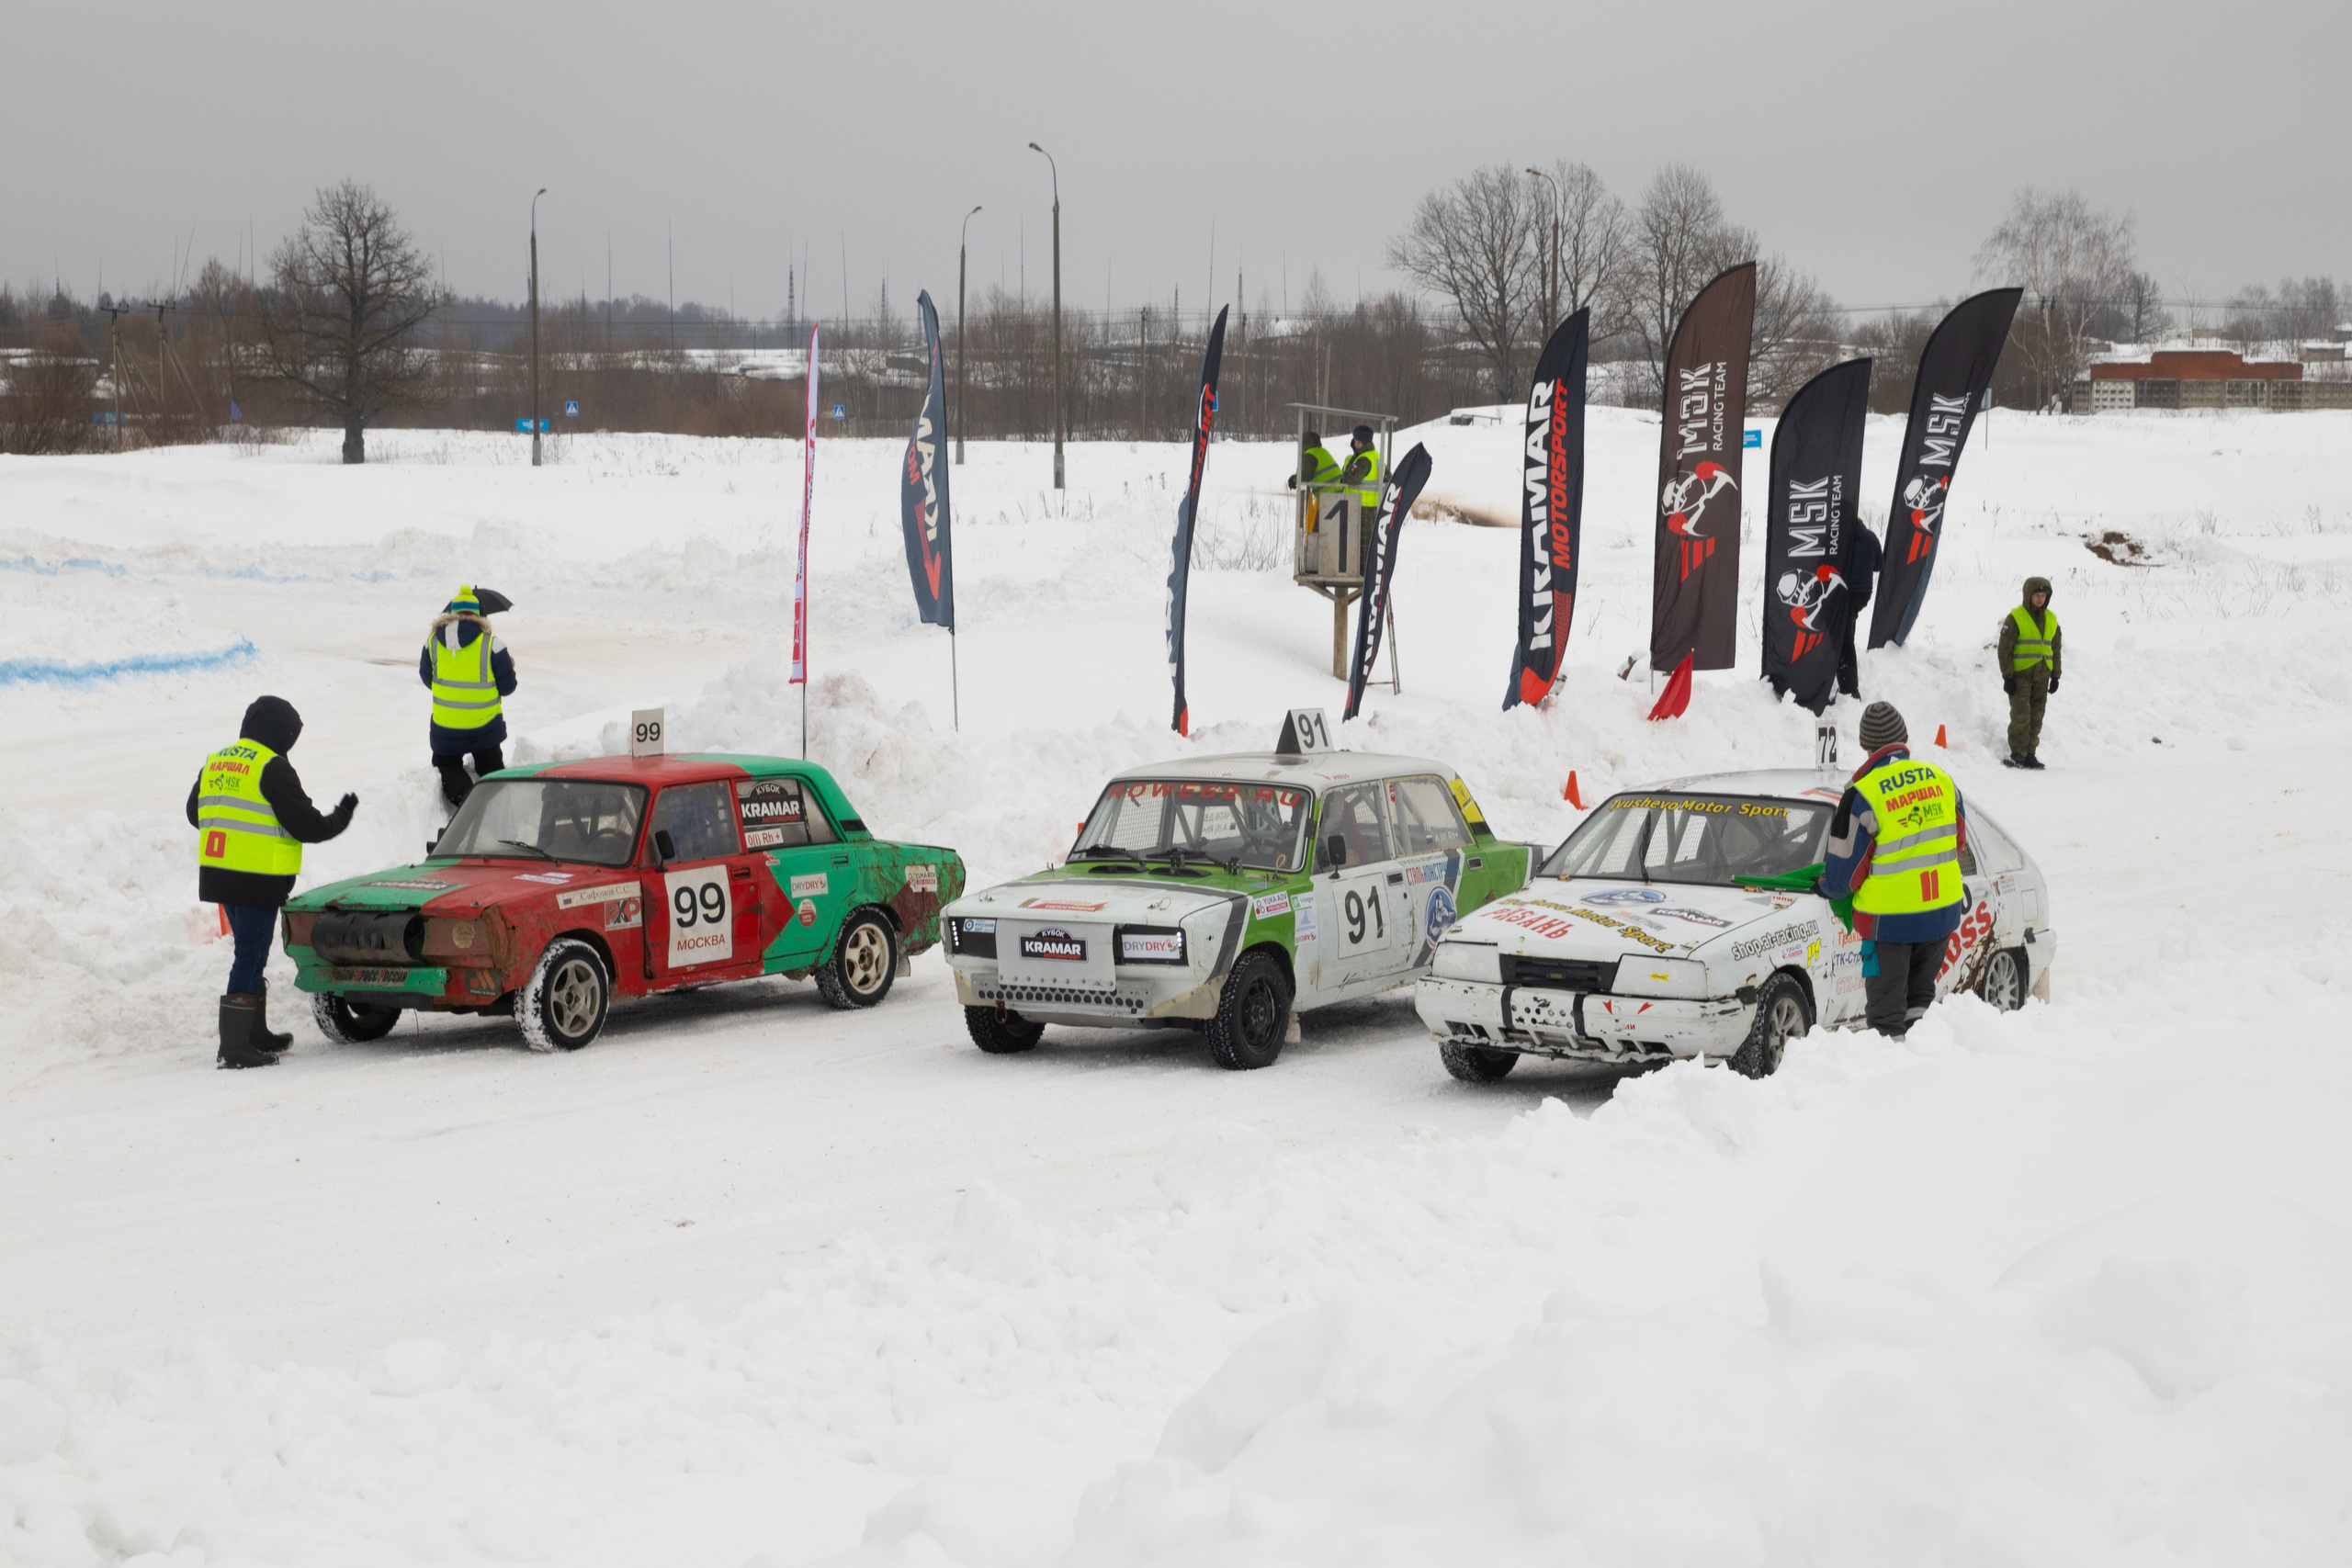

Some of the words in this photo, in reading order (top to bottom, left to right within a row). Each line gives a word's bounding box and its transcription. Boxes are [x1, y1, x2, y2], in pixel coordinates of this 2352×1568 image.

[1715, 361, 1727, 406] TEAM
[1677, 361, 1712, 459] MSK
[1713, 409, 1724, 451] RACING
[1919, 392, 1966, 468] MSK
[1549, 378, 1569, 570] MOTORSPORT
[1831, 475, 1842, 510] TEAM
[1525, 378, 1556, 650] KRAMAR
[1788, 475, 1829, 558] MSK
[1323, 500, 1349, 573] 1
[1829, 511, 1840, 556] RACING
[635, 722, 661, 742] 99
[1297, 712, 1329, 749] 91
[1818, 726, 1838, 763] 72
[756, 784, 781, 795] КУБОК
[1106, 782, 1302, 807] ROWE62.RU
[1879, 767, 1936, 795] RUSTA
[741, 800, 800, 818] KRAMAR
[1679, 800, 1732, 814] Motor
[1885, 785, 1943, 813] МАРШАЛ
[1923, 802, 1944, 818] MSK
[762, 815, 801, 824] MOTORSPORT
[580, 887, 616, 902] Сафонов
[792, 879, 820, 892] DRYDRY
[1263, 896, 1277, 905] YUKA
[674, 883, 727, 928] 99
[1345, 886, 1383, 944] 91
[1657, 908, 1724, 926] KRAMAR
[1041, 929, 1066, 938] КУБОК
[1479, 907, 1575, 939] РЯЗАНЬ
[1566, 908, 1625, 929] Motor
[1616, 925, 1675, 953] Sport
[677, 934, 726, 951] МОСКВА
[1024, 940, 1081, 955] KRAMAR
[1124, 941, 1166, 952] DRYDRY
[1732, 919, 1819, 961] shop.at-racing.ru
